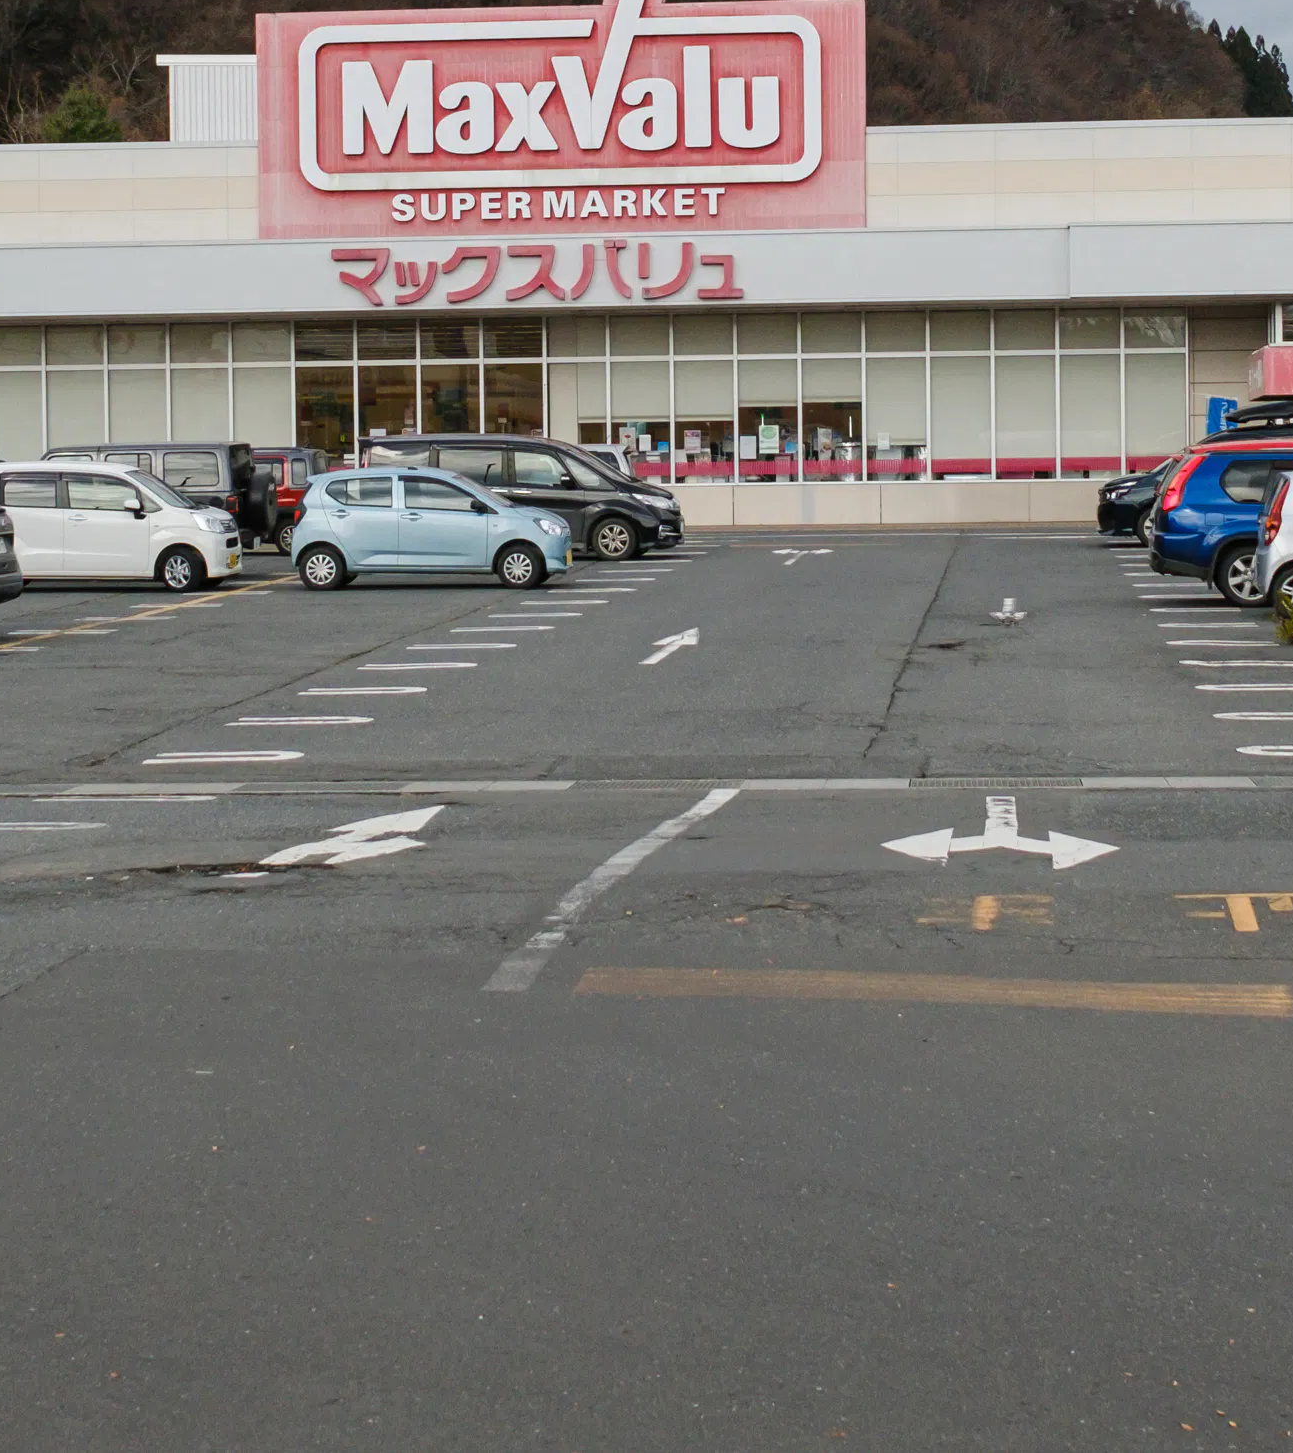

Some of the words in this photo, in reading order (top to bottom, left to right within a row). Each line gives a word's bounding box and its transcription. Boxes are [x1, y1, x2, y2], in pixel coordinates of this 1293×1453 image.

[331, 239, 744, 306] マックスバリュ
